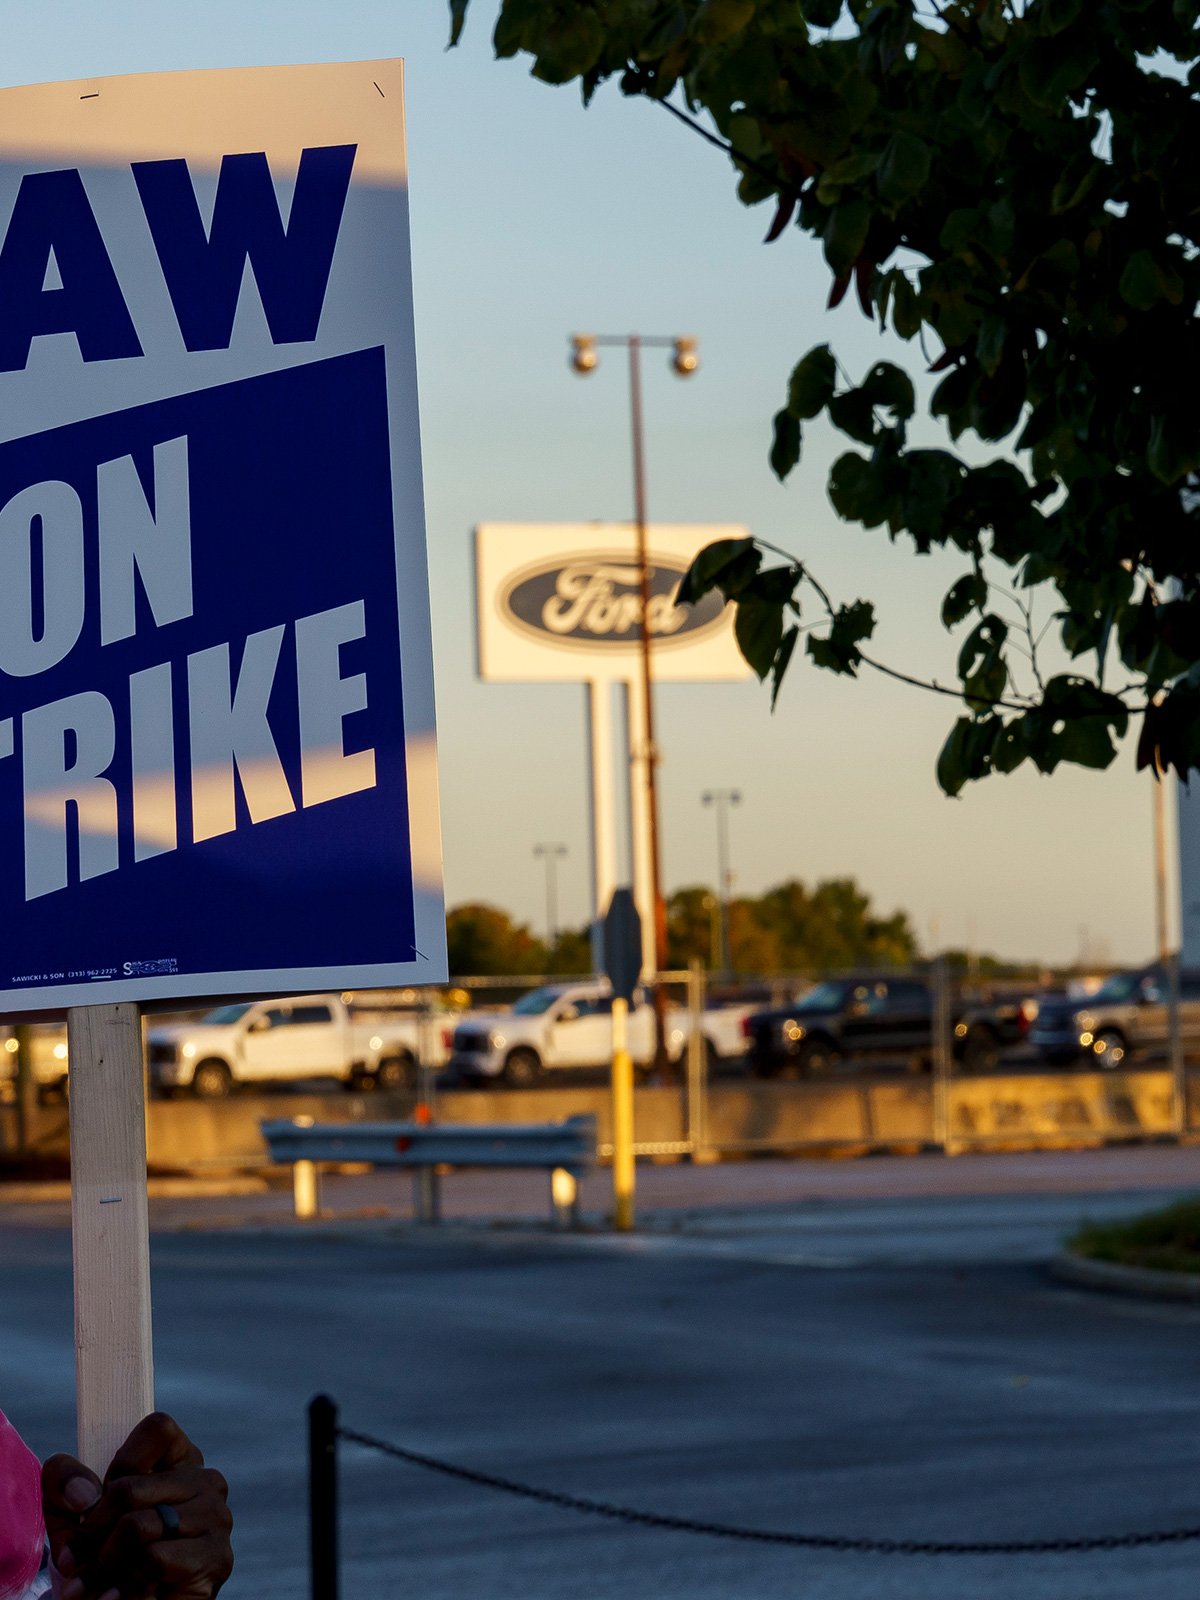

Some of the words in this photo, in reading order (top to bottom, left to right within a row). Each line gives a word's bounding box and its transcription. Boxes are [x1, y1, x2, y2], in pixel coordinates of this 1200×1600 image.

[541, 562, 690, 635] Ford
[11, 974, 42, 983] SAWICKI
[49, 972, 65, 980] SON
[67, 970, 86, 978] (313)
